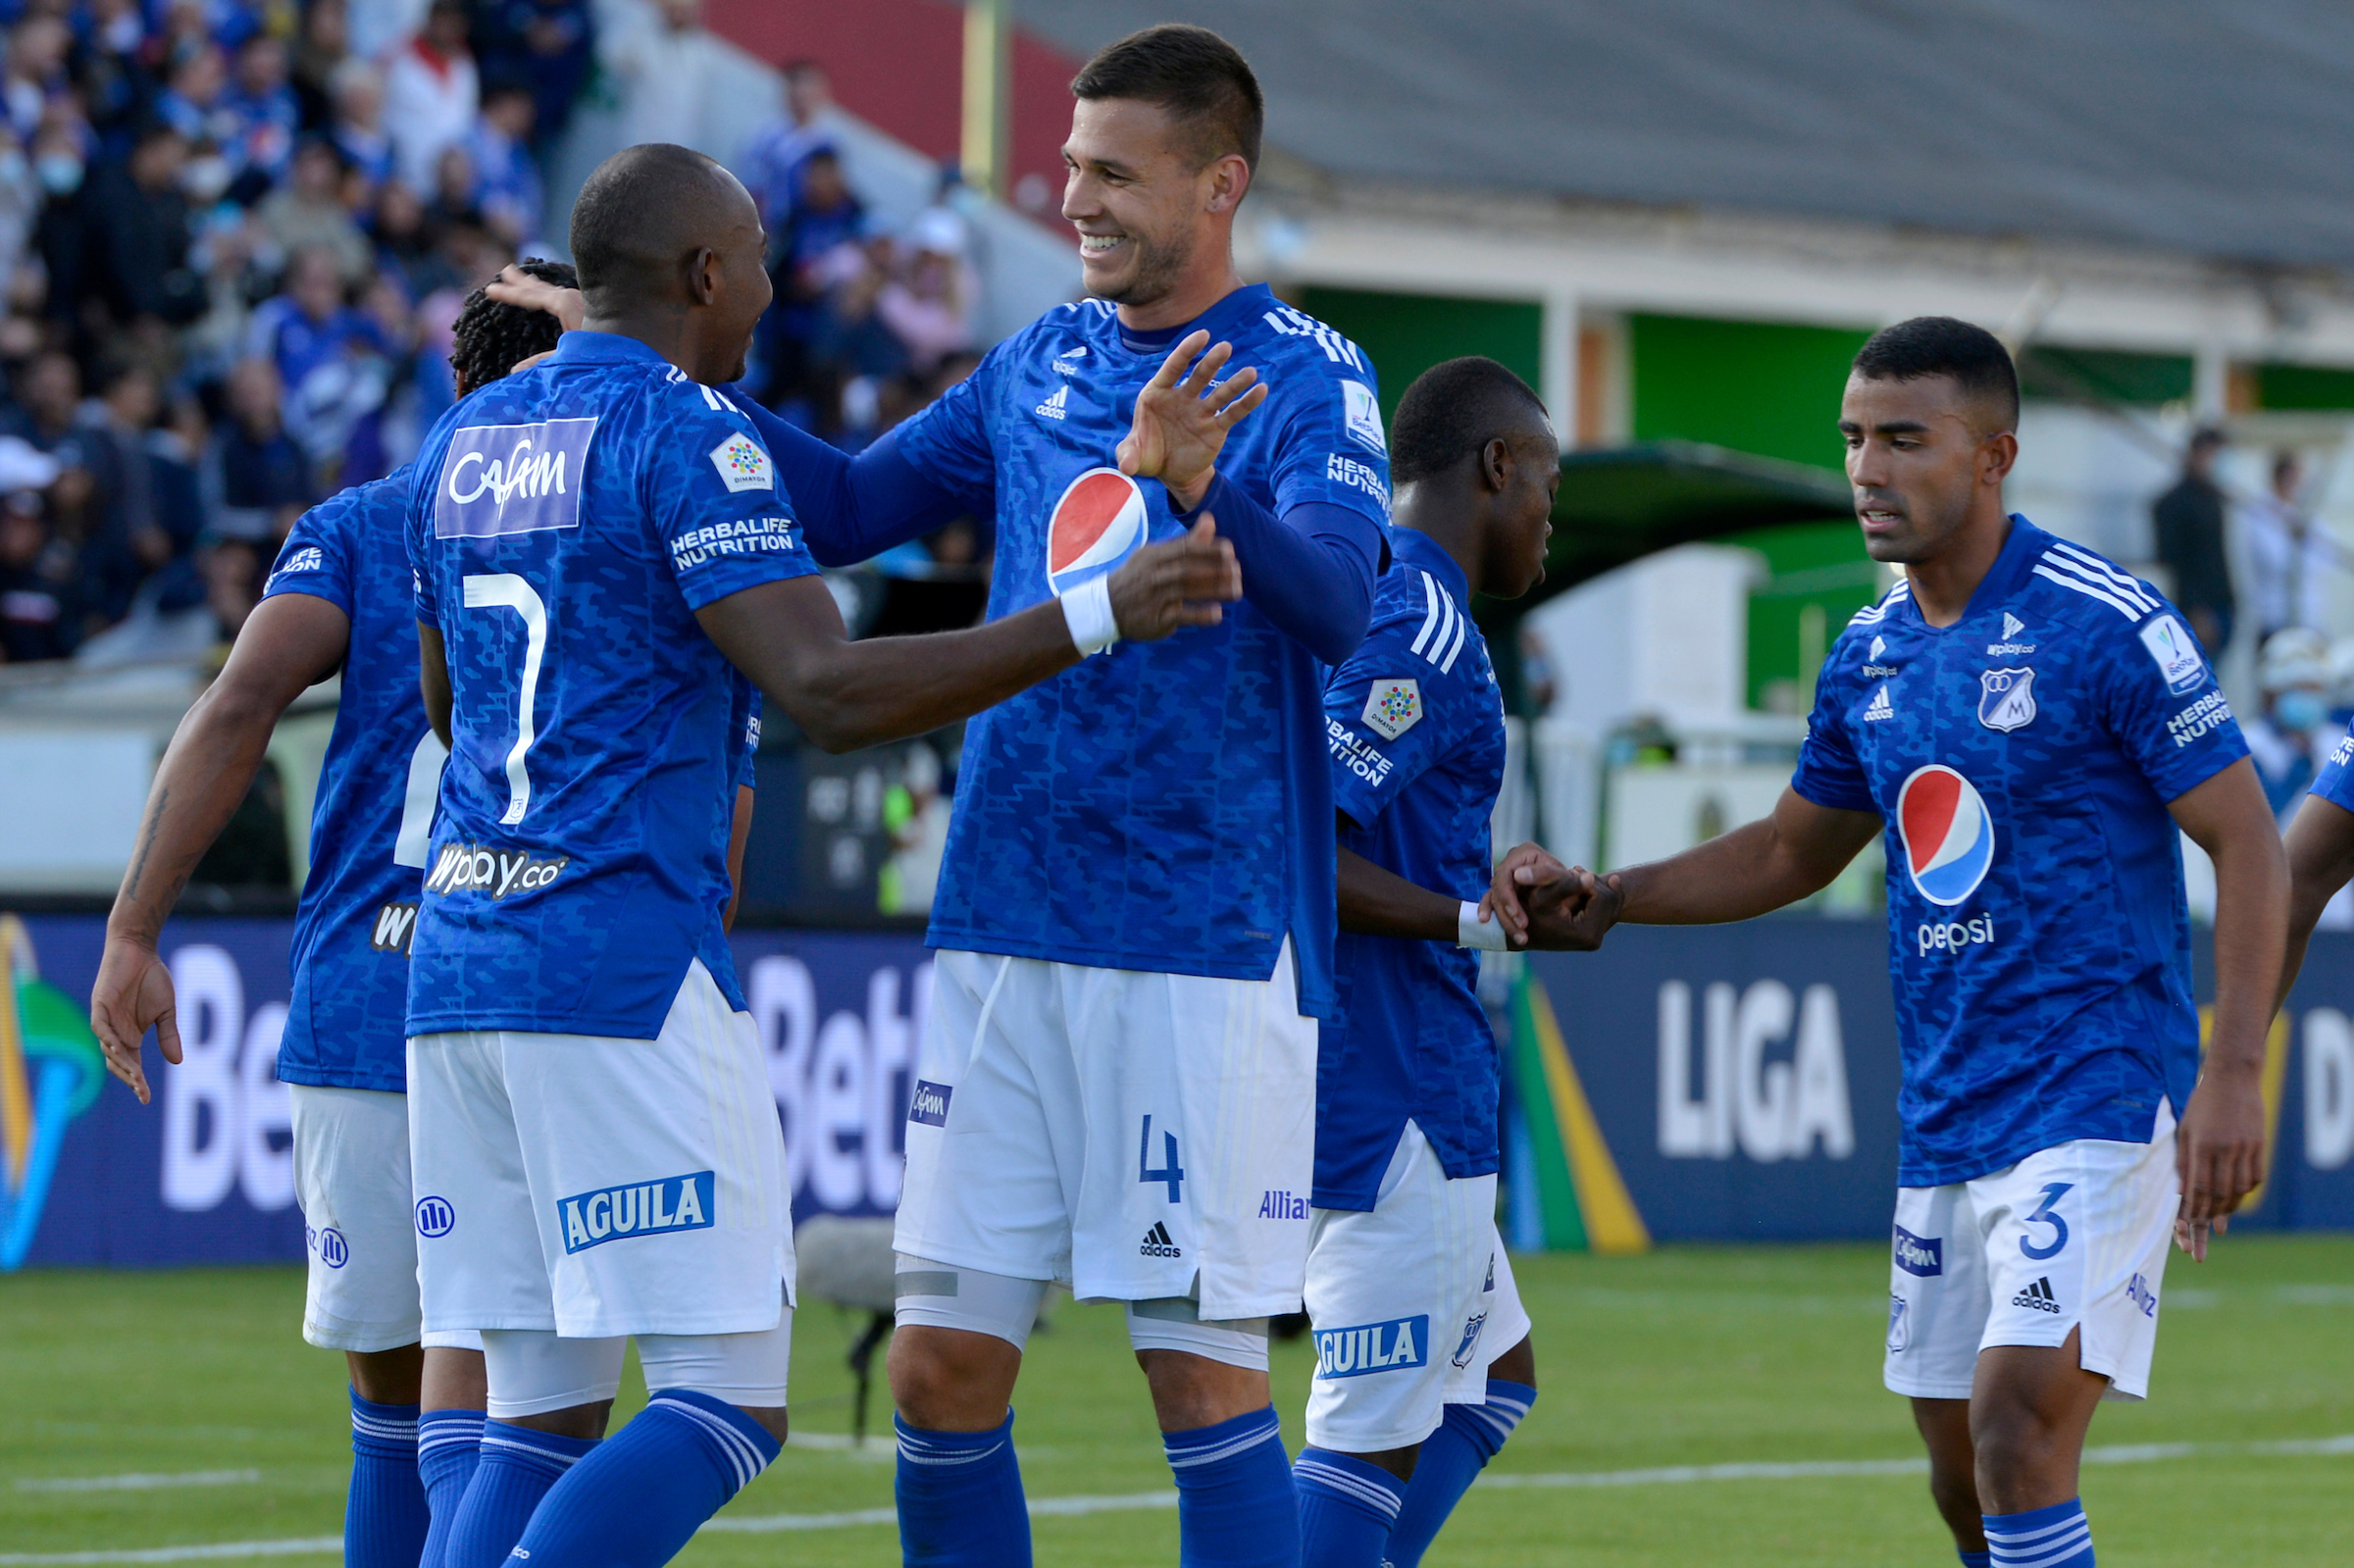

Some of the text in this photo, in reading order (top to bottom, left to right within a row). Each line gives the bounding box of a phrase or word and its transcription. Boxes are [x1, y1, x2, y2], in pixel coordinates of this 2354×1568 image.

[1036, 404, 1066, 421] adidas
[670, 517, 793, 555] HERBALIFE
[675, 534, 794, 571] NUTRITION
[463, 573, 546, 824] 7
[1864, 707, 1894, 722] adidas
[1371, 713, 1398, 734] DIMAYOR
[1918, 911, 1995, 957] pepsi
[1658, 980, 1855, 1163] LIGA
[1139, 1114, 1184, 1203] 4
[566, 1178, 706, 1250] AGUILA
[2020, 1182, 2075, 1260] 3
[1140, 1243, 1181, 1258] adidas
[2013, 1295, 2061, 1314] adidas
